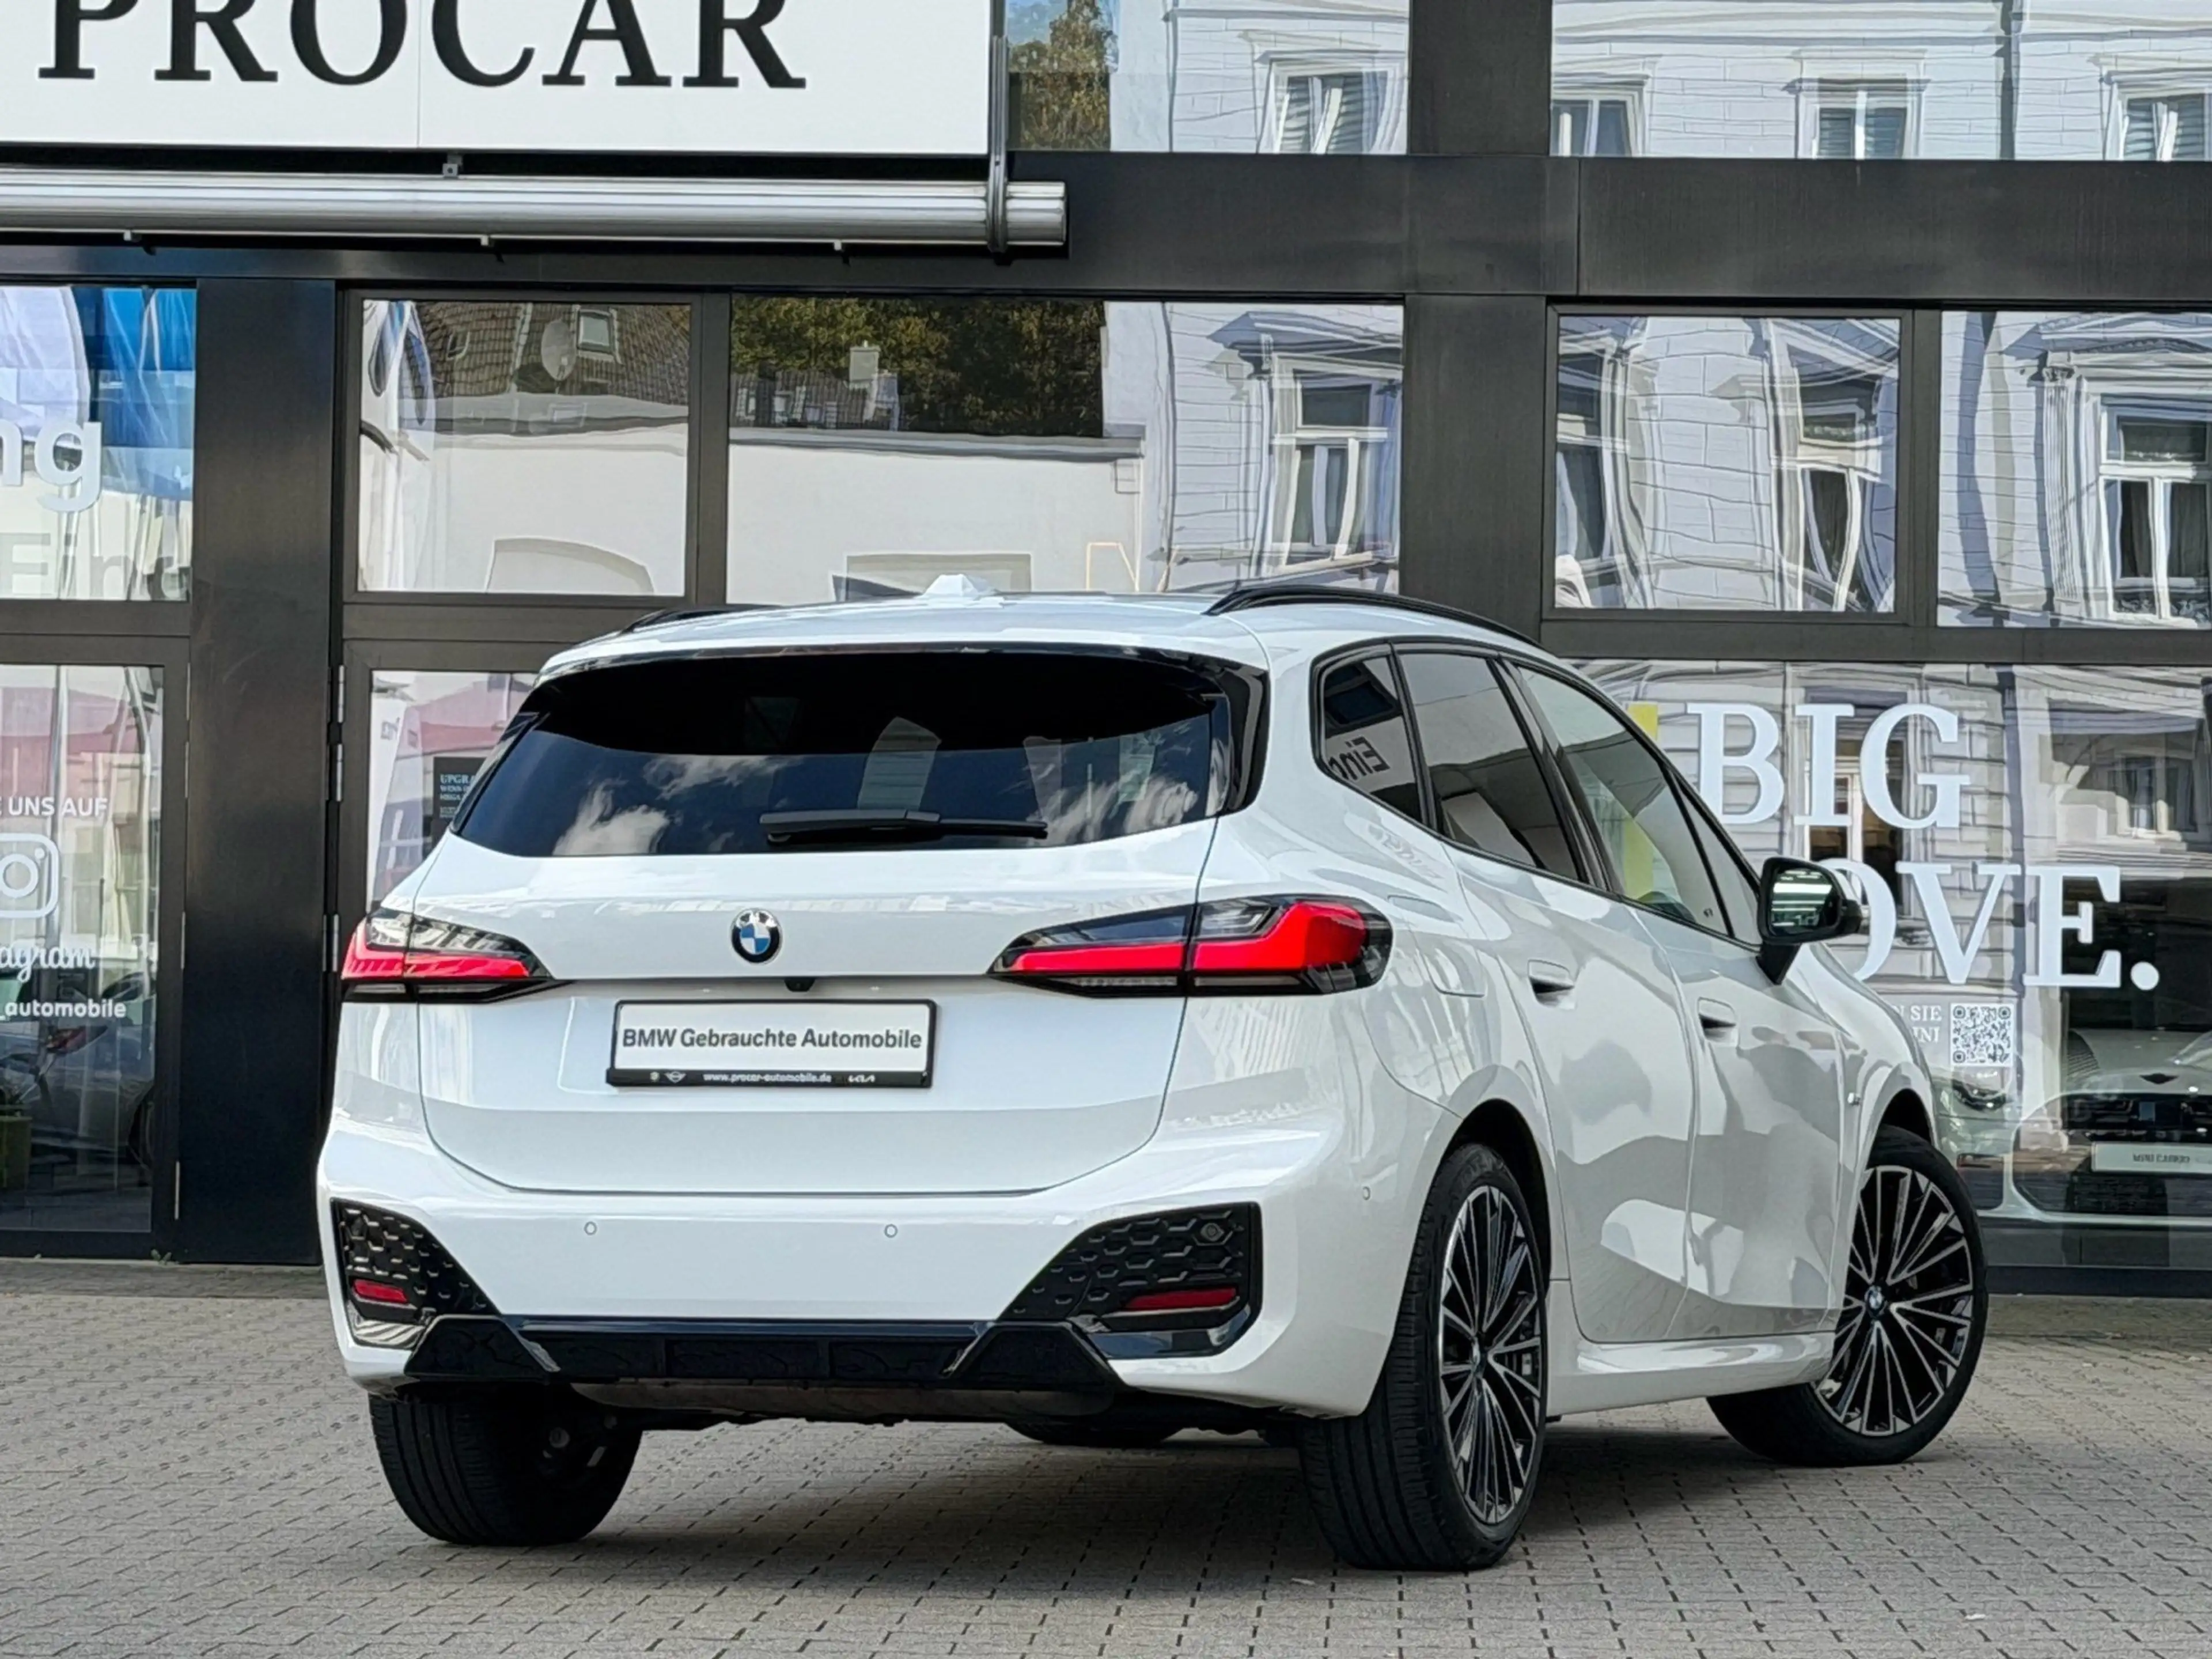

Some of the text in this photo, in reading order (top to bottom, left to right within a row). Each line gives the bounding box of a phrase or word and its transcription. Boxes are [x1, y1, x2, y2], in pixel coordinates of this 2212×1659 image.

[38, 0, 806, 88] PROCAR
[1687, 702, 1970, 830] BIG
[9, 797, 55, 816] UNS
[62, 797, 108, 816] AUF
[1910, 1005, 1942, 1021] SIE
[622, 1028, 922, 1048] BMW Gebrauchte Automobile
